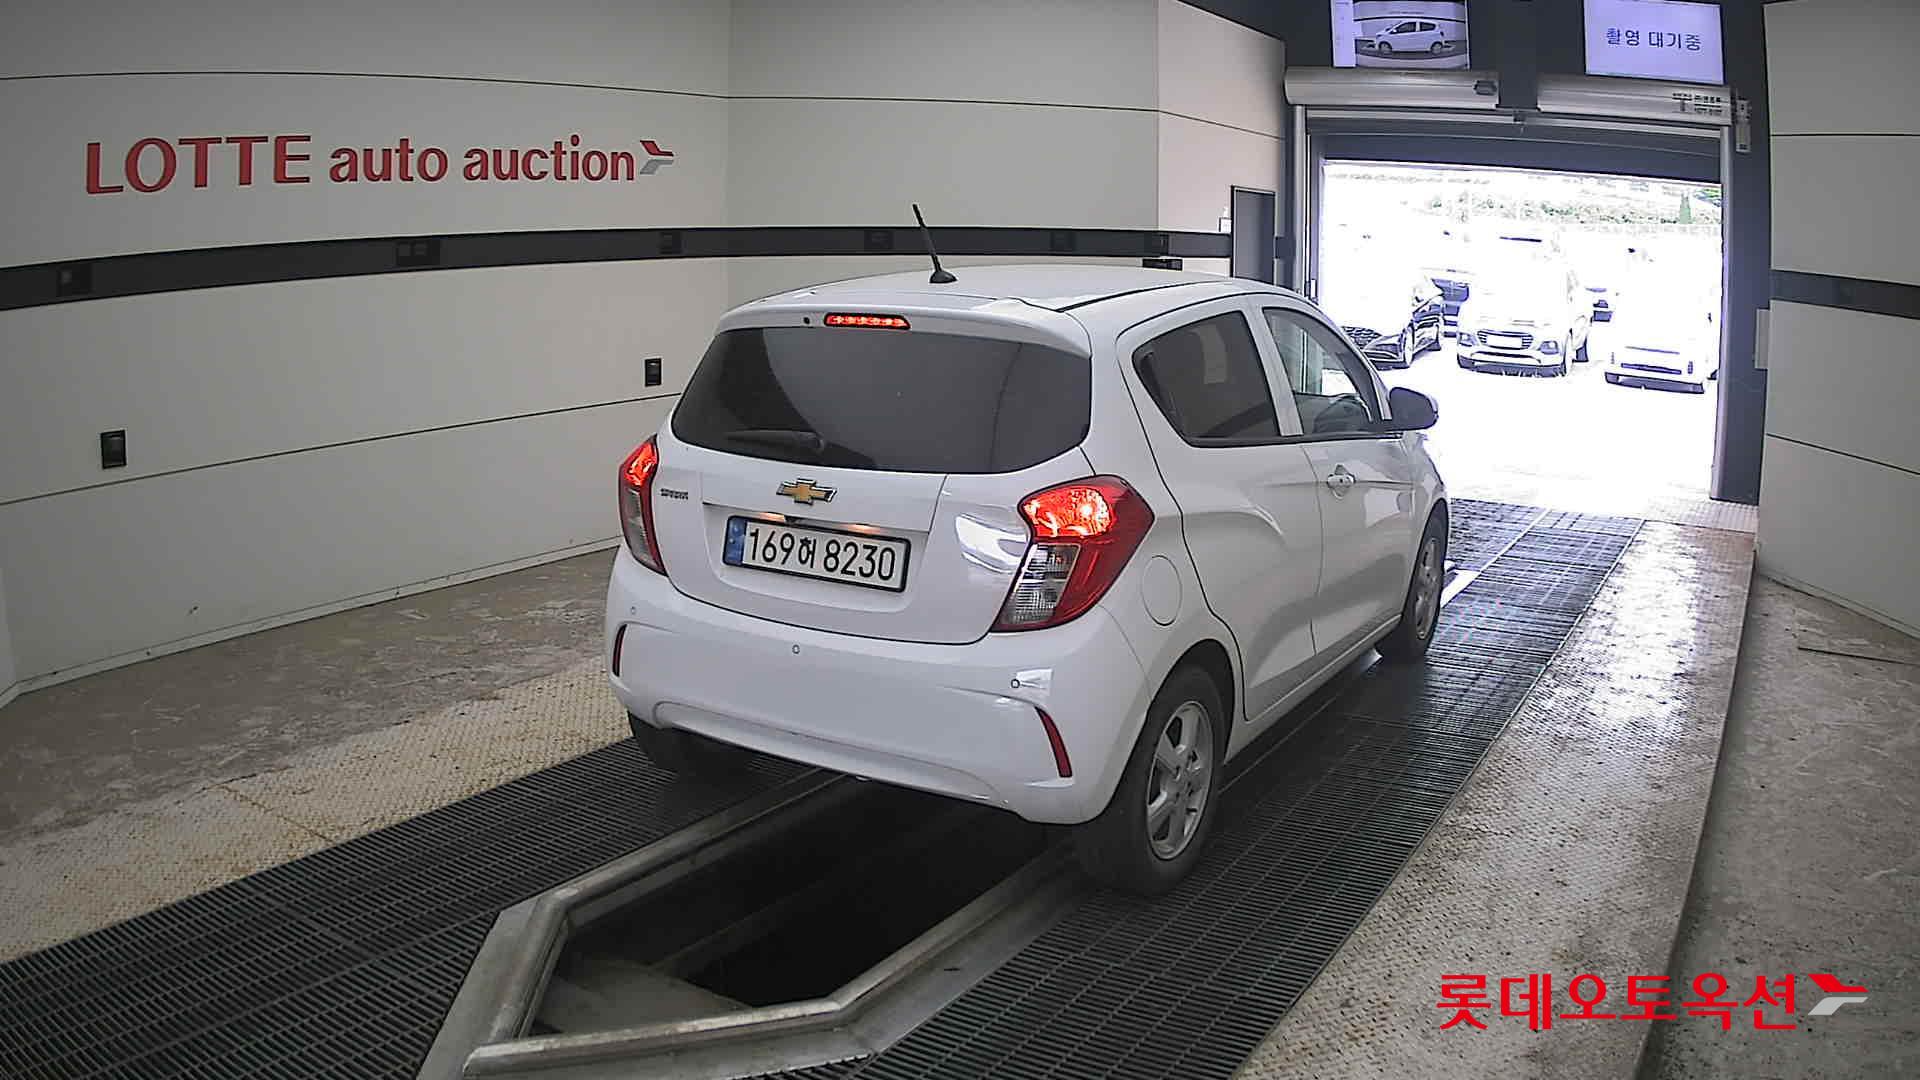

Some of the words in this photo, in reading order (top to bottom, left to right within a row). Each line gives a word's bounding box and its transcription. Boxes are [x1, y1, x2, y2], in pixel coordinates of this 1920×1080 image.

[1647, 31, 1702, 52] 대기중
[86, 135, 311, 194] LOTTE
[329, 138, 448, 183] auto
[463, 134, 635, 182] auction
[750, 527, 817, 569] 169허
[823, 539, 896, 581] 8230
